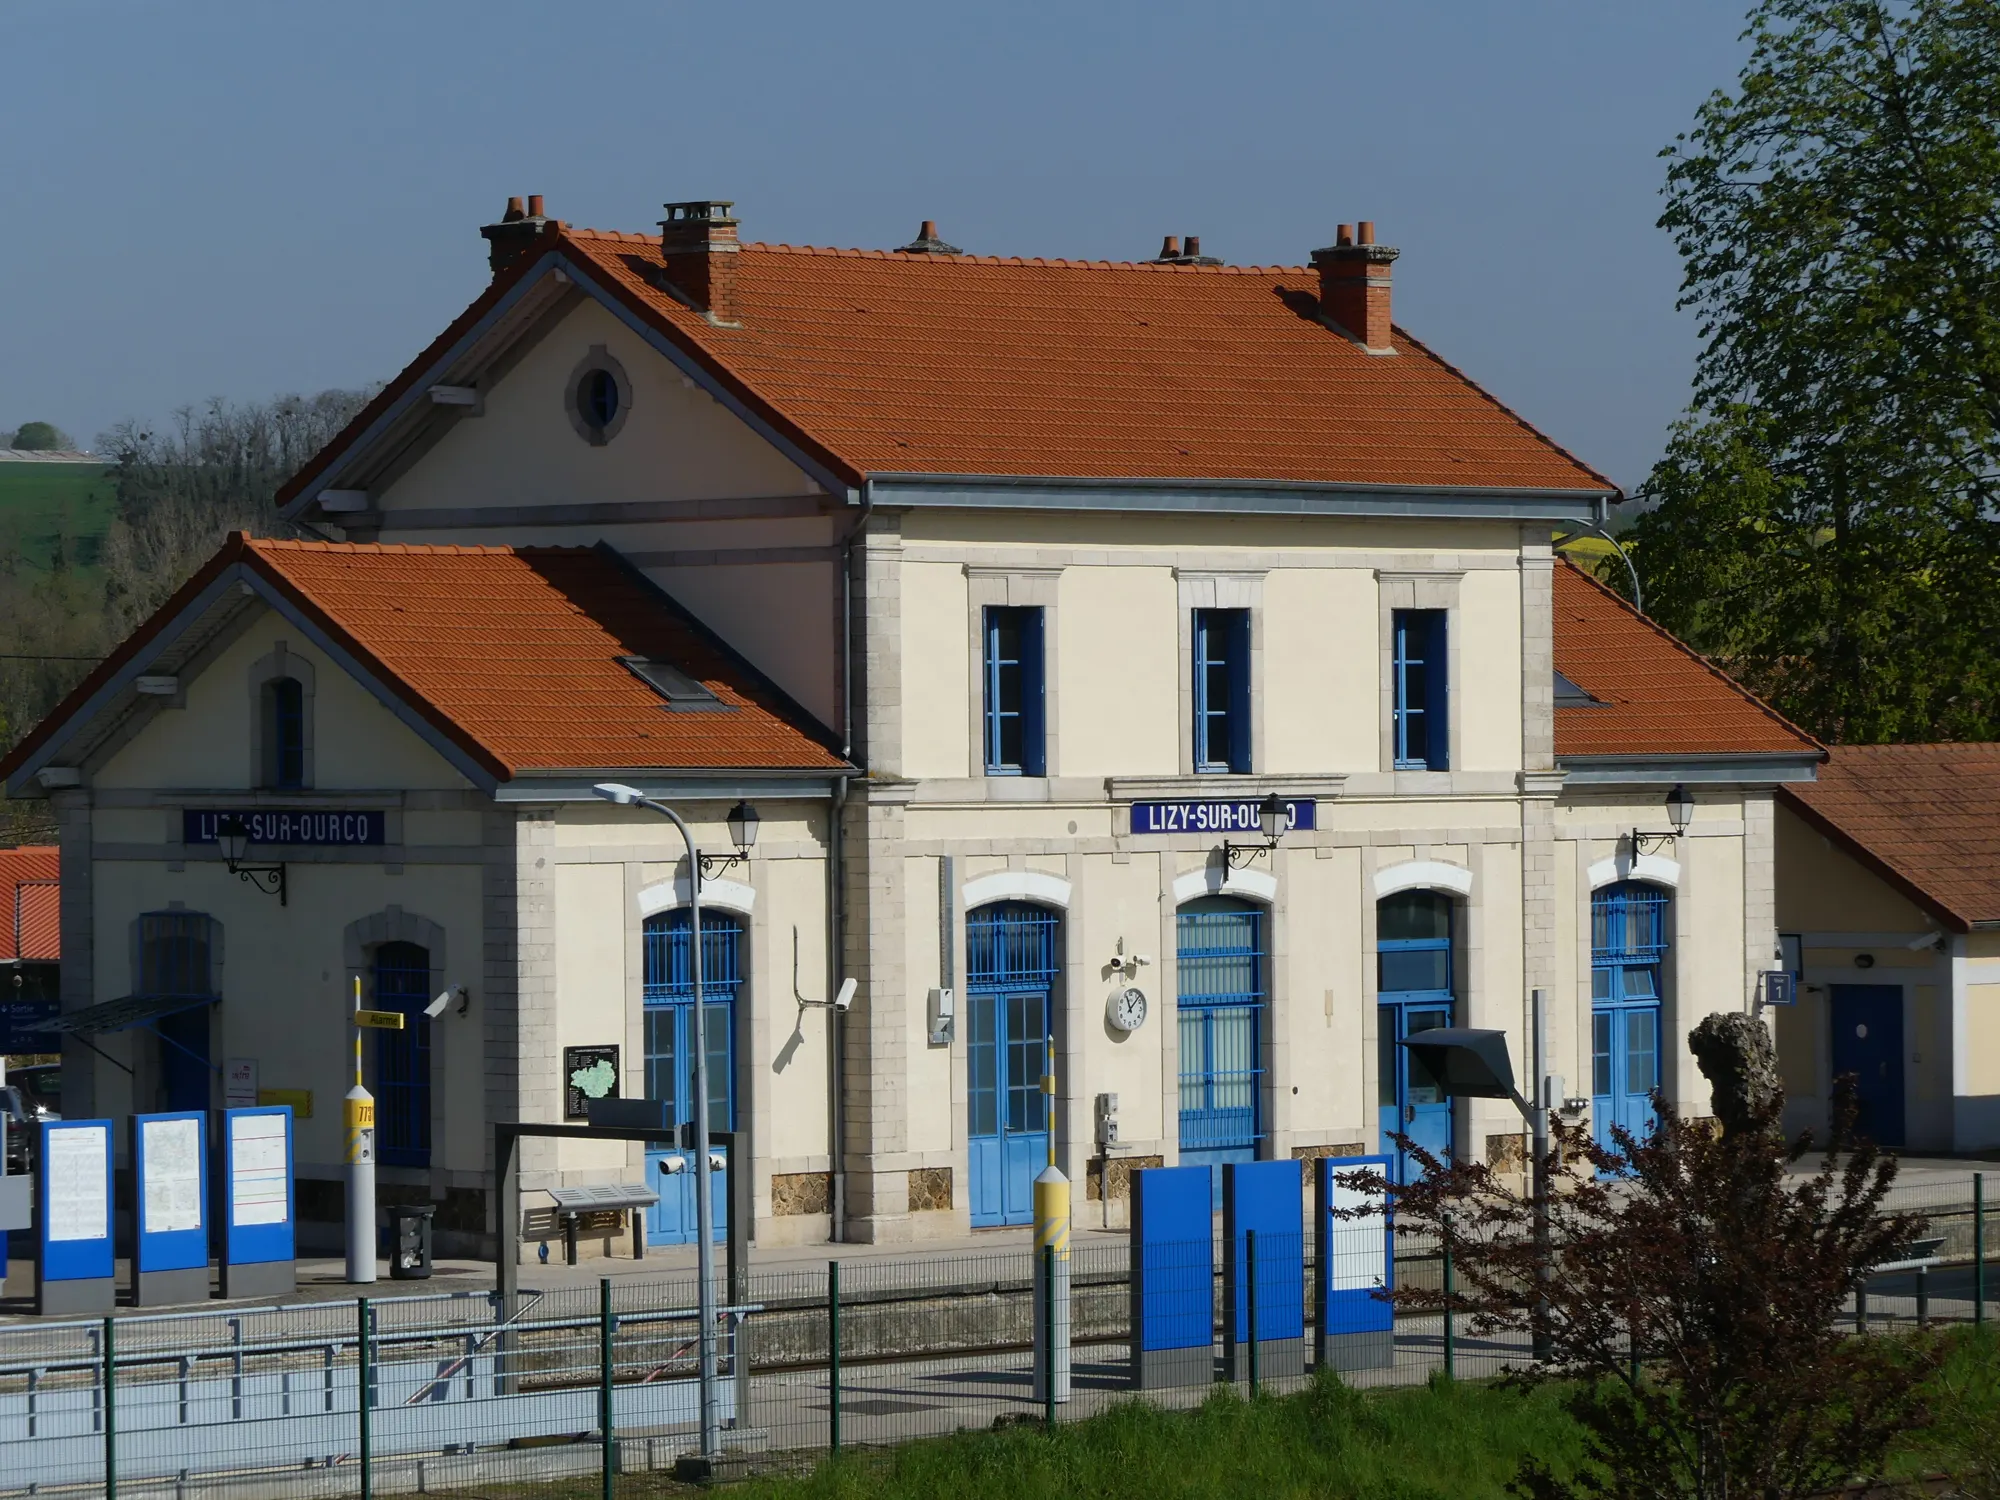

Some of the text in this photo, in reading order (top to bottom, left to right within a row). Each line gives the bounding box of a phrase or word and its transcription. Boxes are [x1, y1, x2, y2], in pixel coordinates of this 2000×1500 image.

[1150, 803, 1296, 830] LIZY-SUR-OUQ
[201, 814, 368, 843] LI-SUR-OURCQ
[1775, 985, 1782, 999] 1
[11, 1004, 35, 1013] Sortie
[370, 1014, 398, 1026] Alarme
